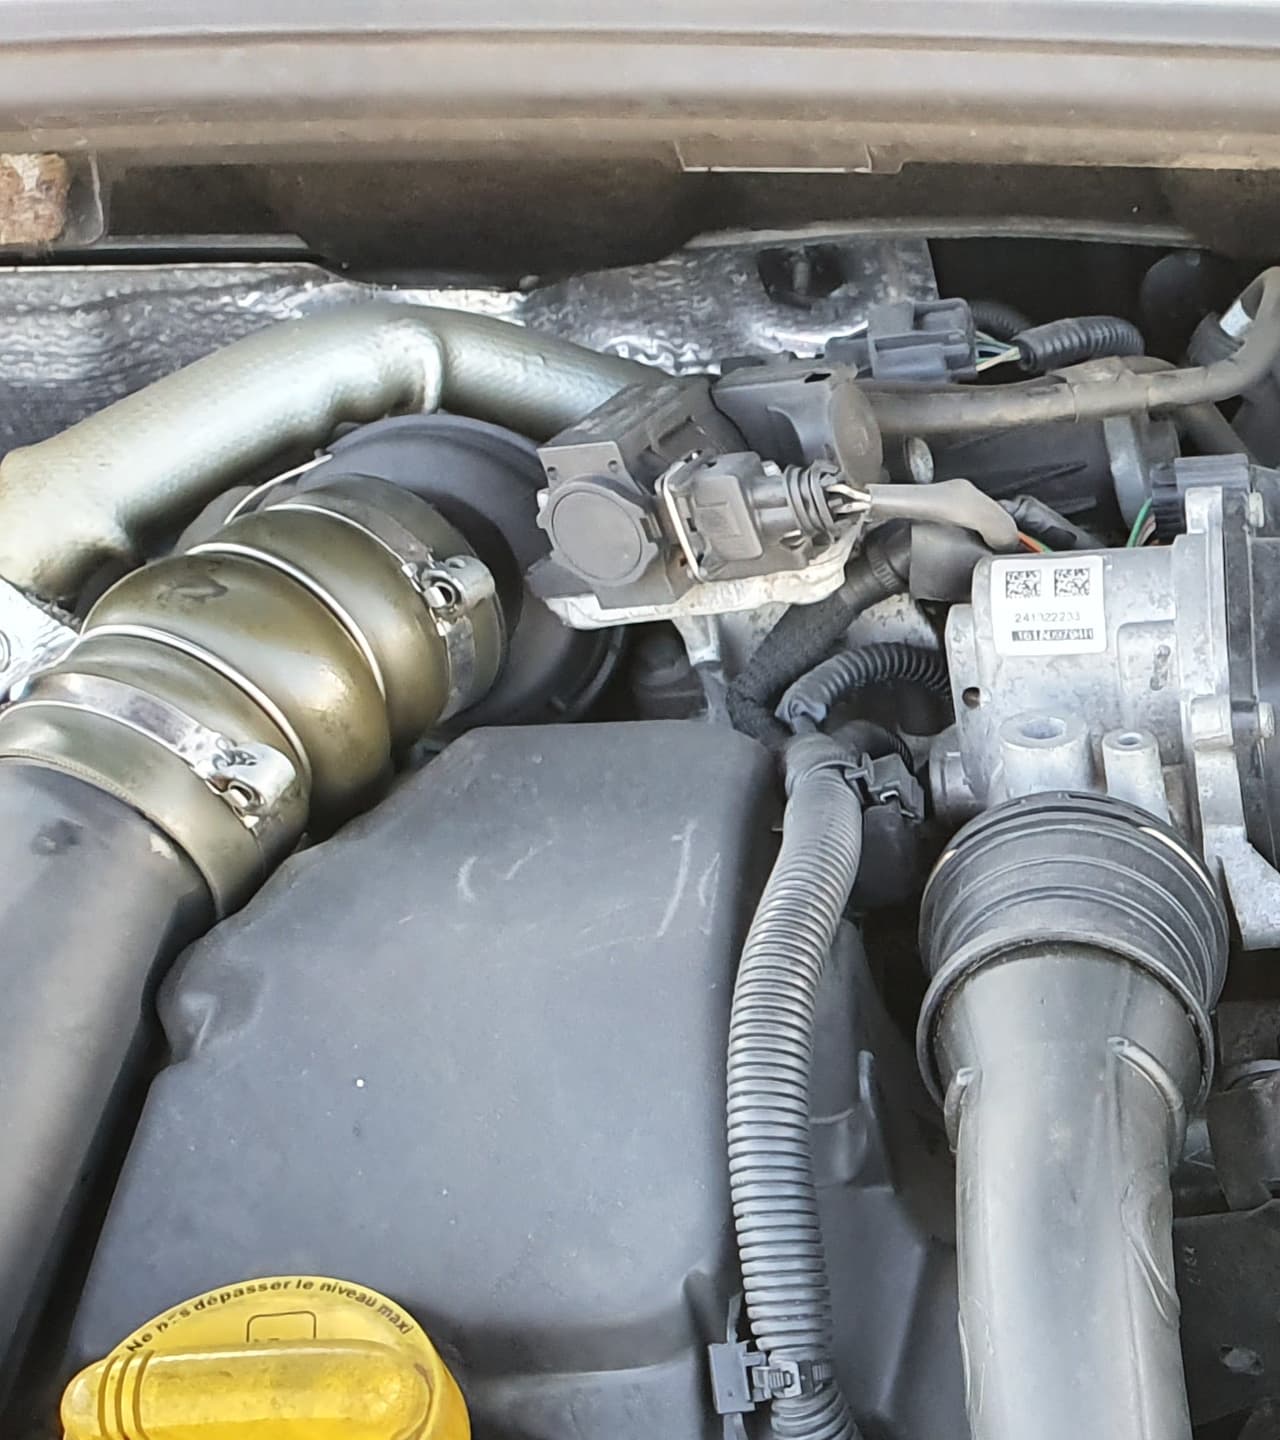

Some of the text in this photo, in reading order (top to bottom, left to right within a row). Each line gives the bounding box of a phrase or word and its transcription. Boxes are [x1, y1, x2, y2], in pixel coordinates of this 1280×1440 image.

[193, 1279, 292, 1312] dépasser
[296, 1279, 314, 1290] le
[320, 1280, 378, 1309] niveau
[376, 1304, 414, 1335] maxi
